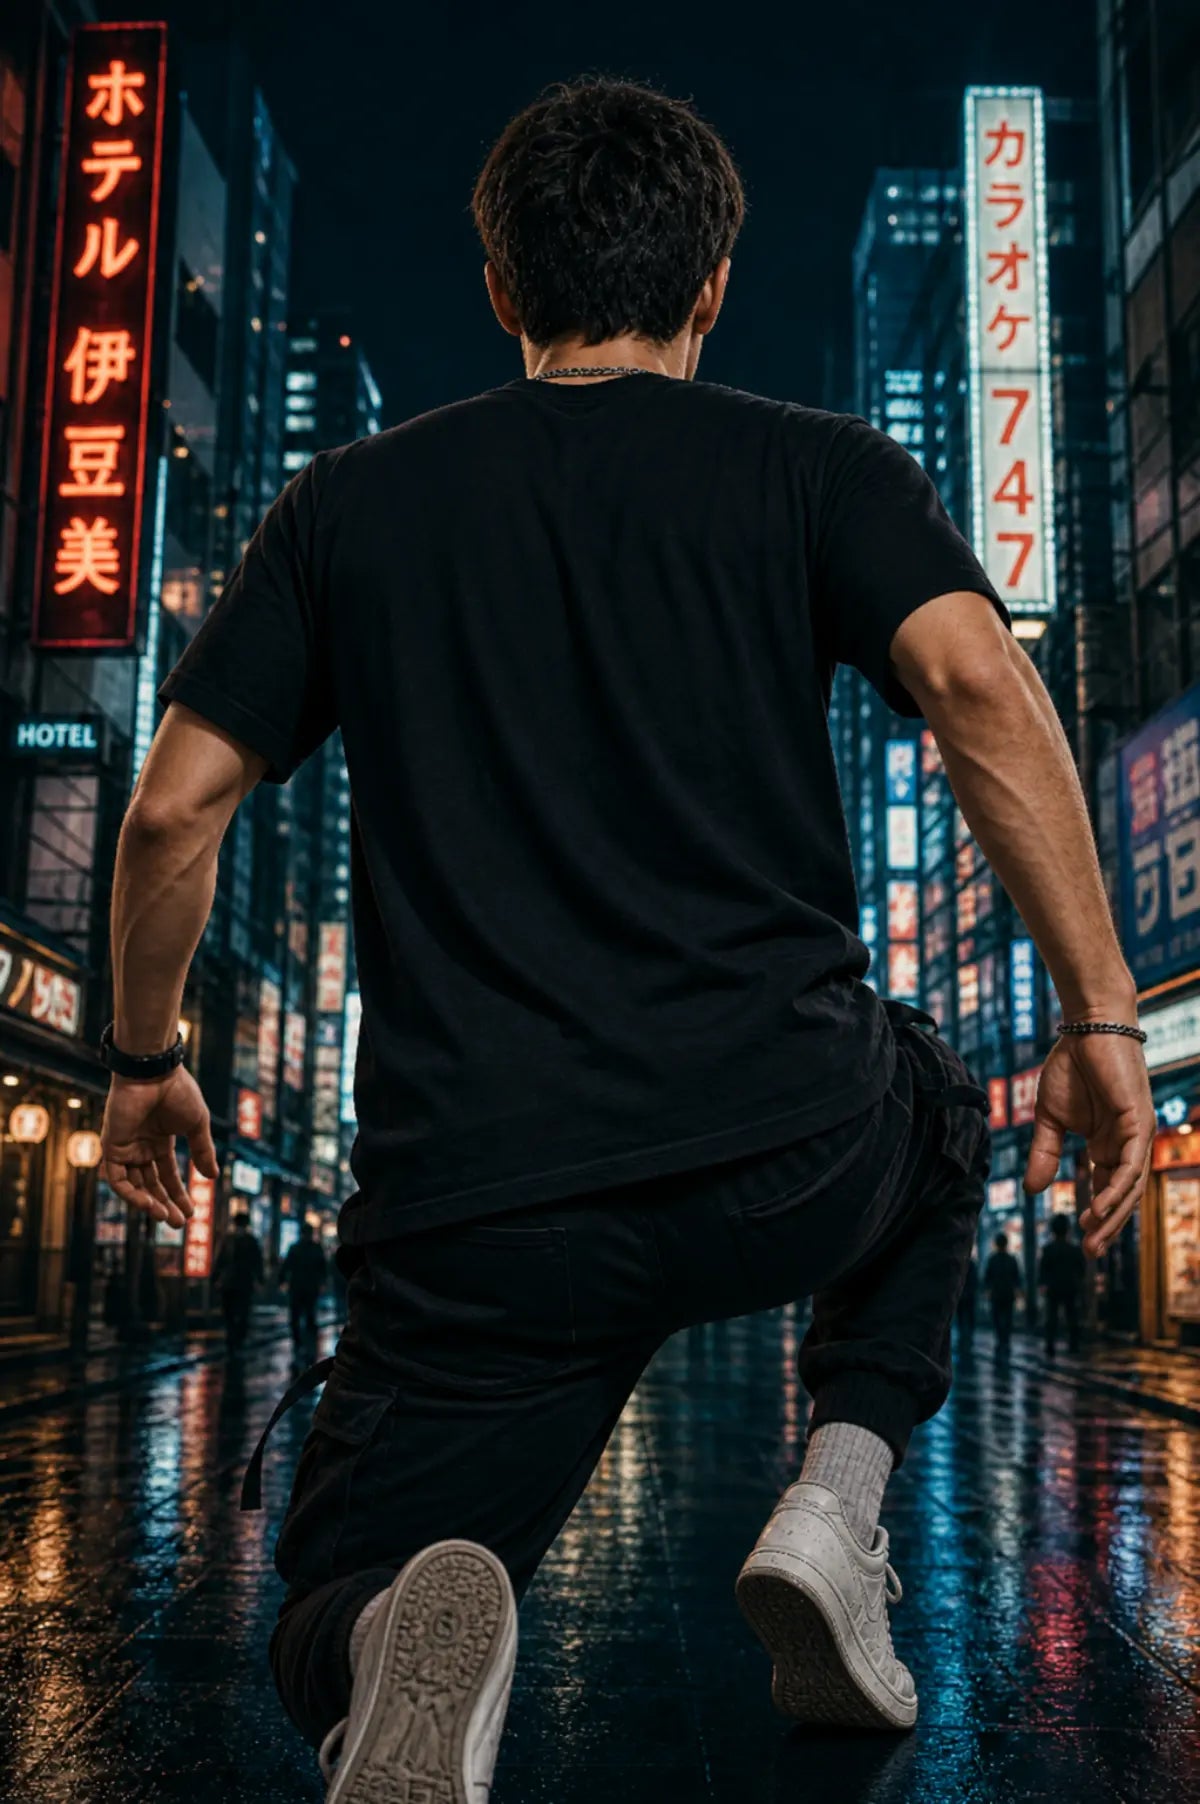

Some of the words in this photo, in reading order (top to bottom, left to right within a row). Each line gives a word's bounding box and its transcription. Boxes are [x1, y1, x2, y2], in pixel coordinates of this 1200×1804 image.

[73, 60, 145, 279] ホテル
[984, 121, 1031, 352] カラオケ
[54, 326, 136, 595] 伊豆美
[992, 389, 1035, 587] 747
[17, 723, 97, 748] HOTEL
